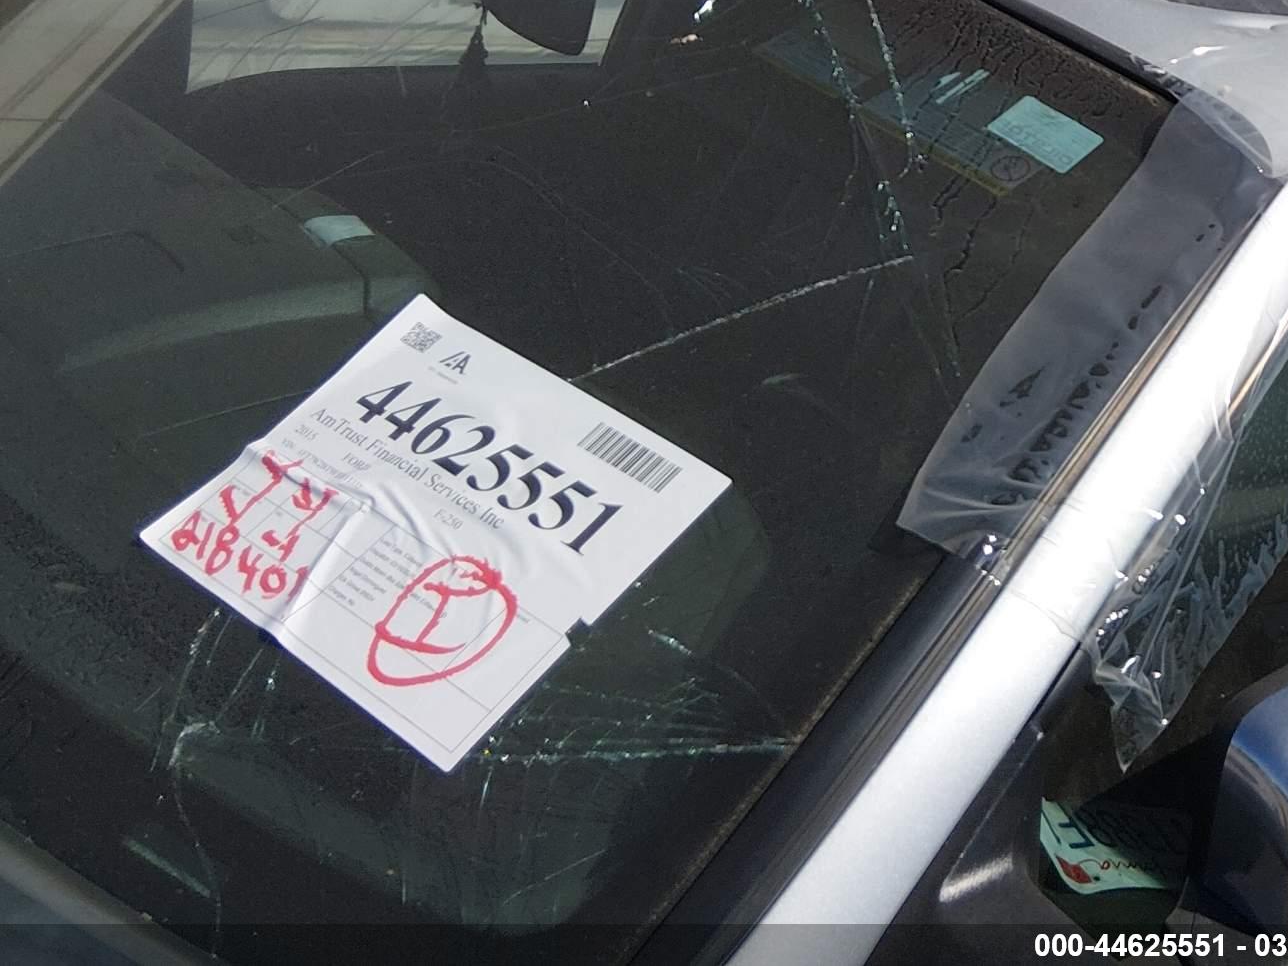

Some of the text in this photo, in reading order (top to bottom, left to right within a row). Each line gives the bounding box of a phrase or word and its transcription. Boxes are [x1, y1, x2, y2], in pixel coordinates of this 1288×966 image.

[310, 408, 366, 447] AmTrust
[366, 438, 428, 481] Financial
[424, 474, 481, 516] Services
[479, 507, 504, 530] Inc
[356, 380, 625, 556] 44625551
